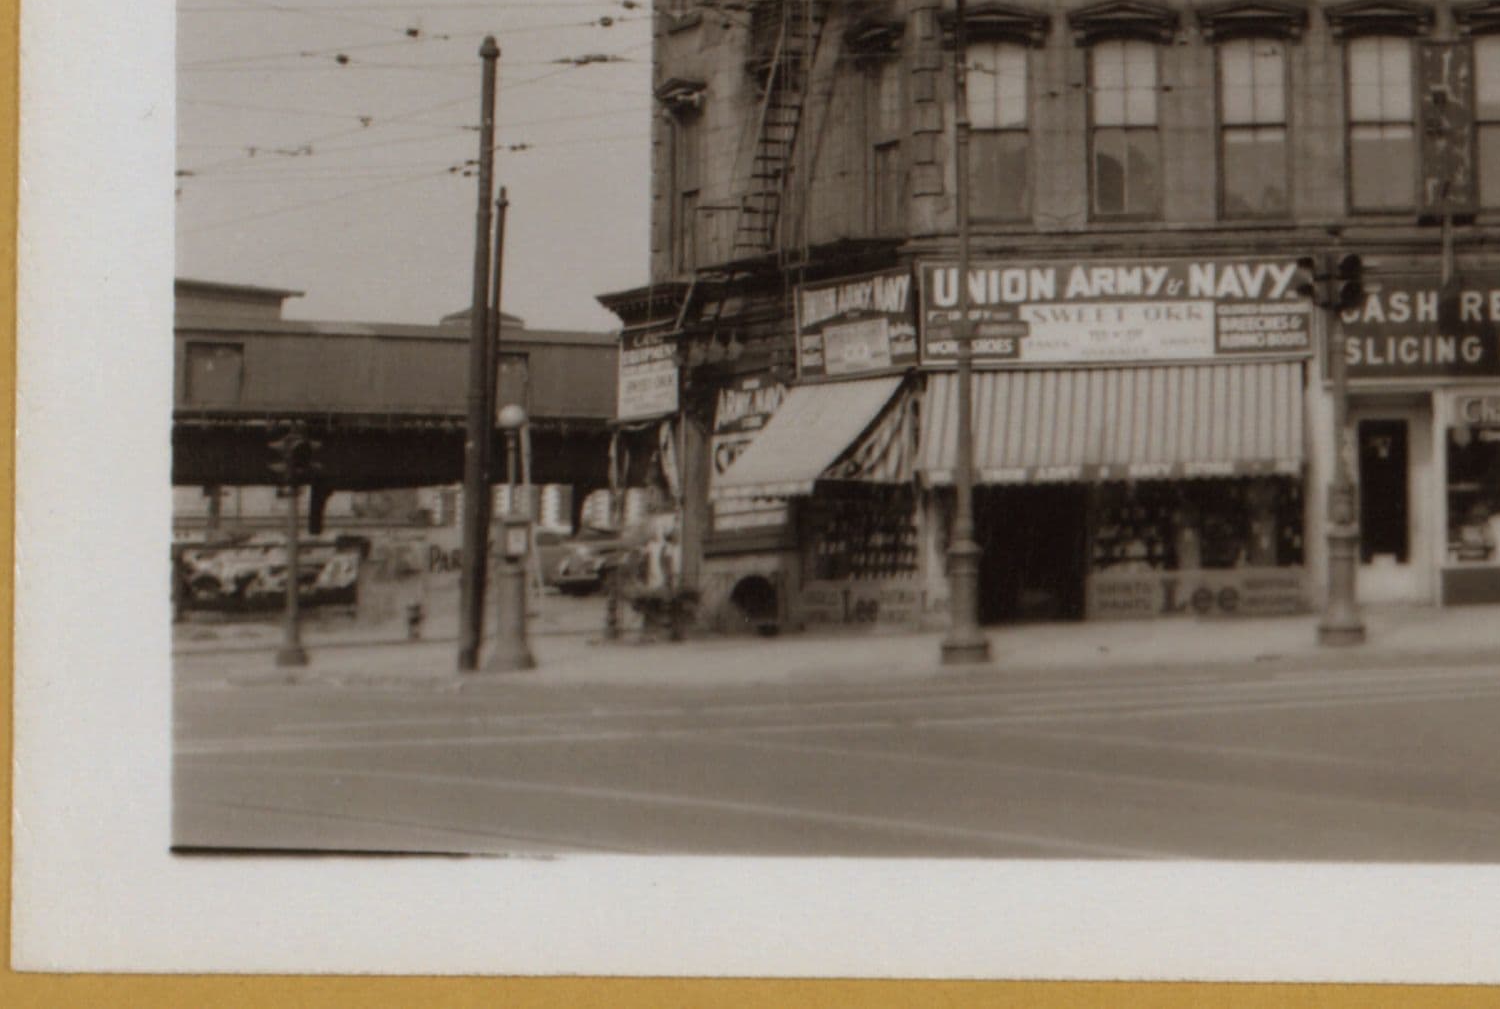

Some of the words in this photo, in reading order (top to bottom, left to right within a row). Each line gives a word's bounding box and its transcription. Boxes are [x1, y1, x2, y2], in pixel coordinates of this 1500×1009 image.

[932, 268, 1057, 307] UNION
[1065, 265, 1164, 298] ARMY
[1345, 337, 1482, 365] SLICING
